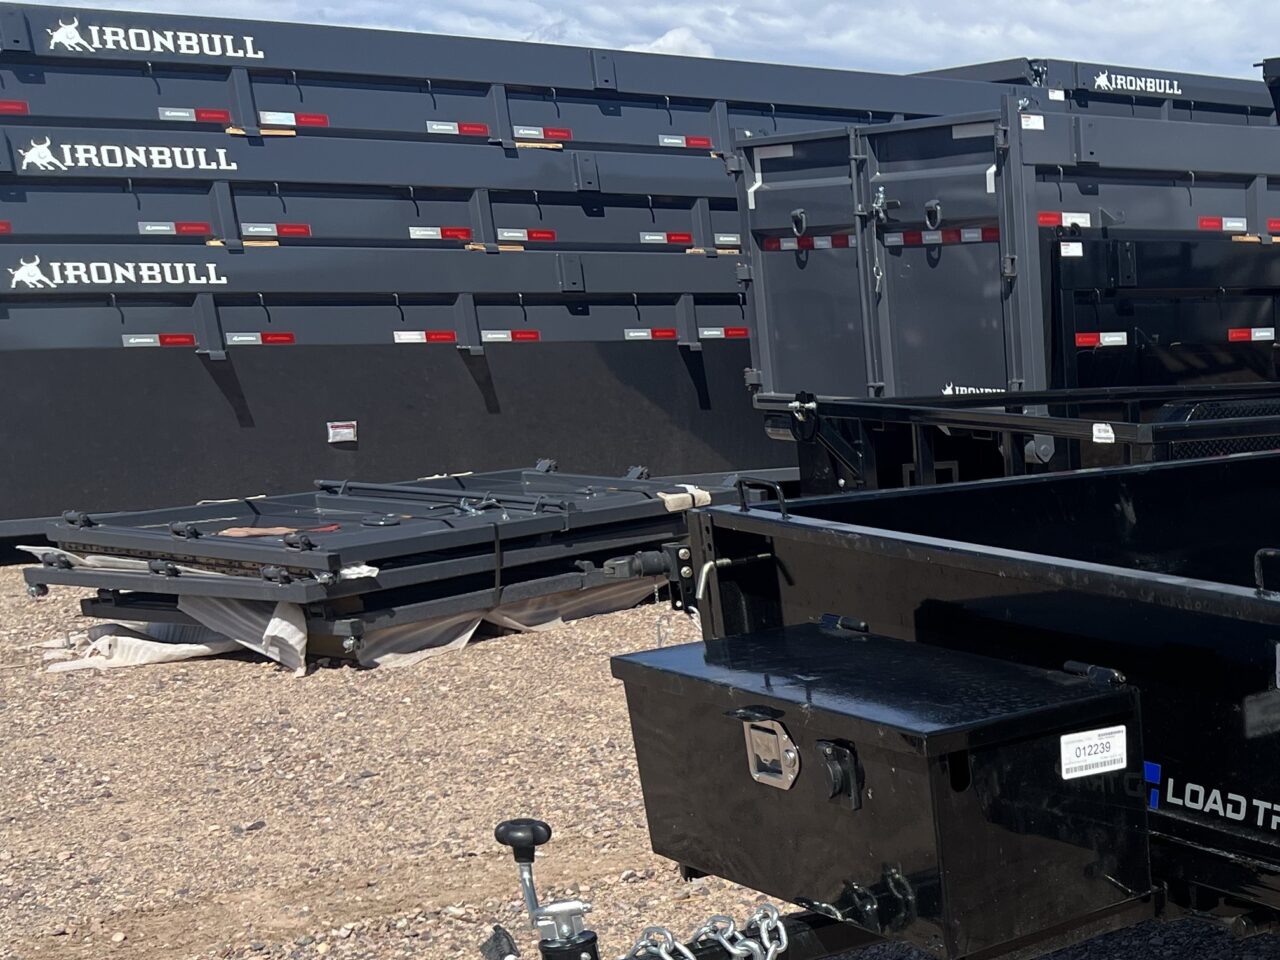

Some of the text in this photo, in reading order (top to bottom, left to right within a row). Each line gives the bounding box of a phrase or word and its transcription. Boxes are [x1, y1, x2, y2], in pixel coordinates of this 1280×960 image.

[88, 25, 265, 59] IRONBULL
[1111, 74, 1182, 95] IRONBULL
[61, 145, 238, 171] IRONBULL
[50, 261, 228, 286] IRONBULL
[1075, 741, 1111, 758] 012239
[1166, 777, 1247, 822] LOAD
